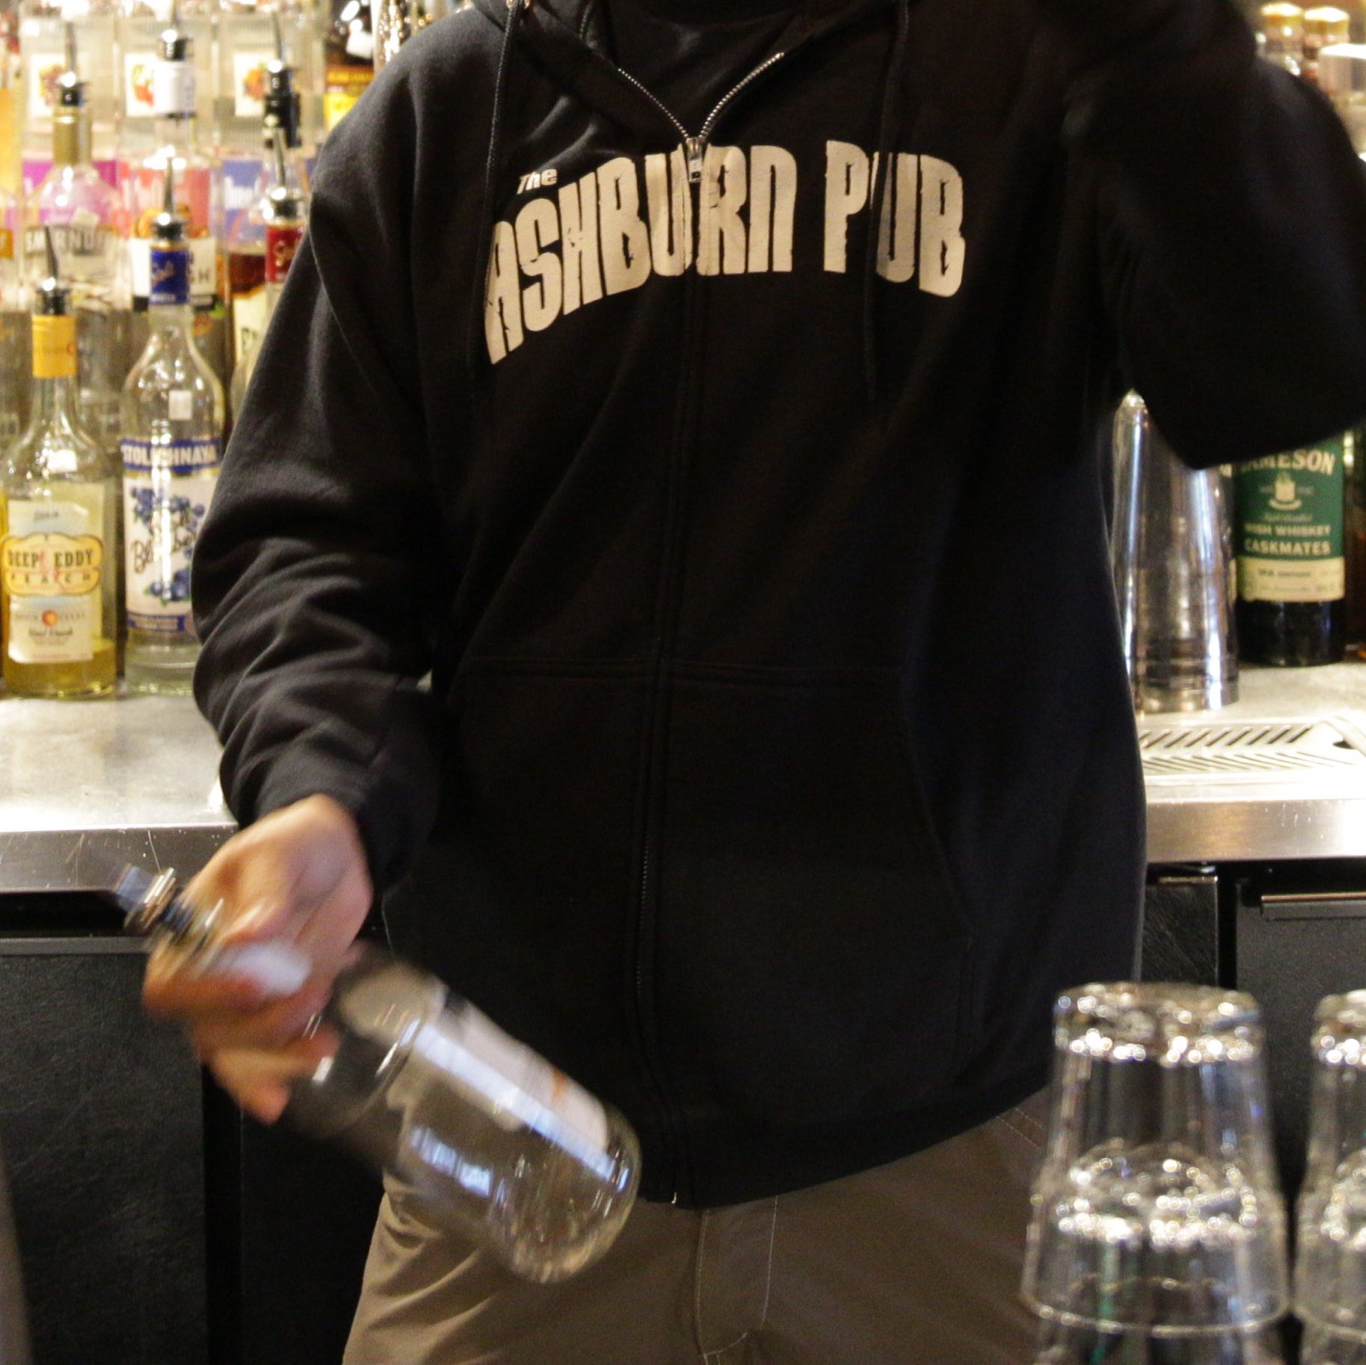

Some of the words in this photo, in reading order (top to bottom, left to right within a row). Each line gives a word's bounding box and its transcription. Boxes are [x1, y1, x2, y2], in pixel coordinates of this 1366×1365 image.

[517, 166, 558, 195] The
[25, 228, 116, 253] SMRNOFF
[483, 142, 798, 365] ASHBURN
[823, 139, 967, 298] PUB
[120, 444, 218, 466] STOLHNAYA
[1275, 524, 1332, 537] WHISKEY
[7, 550, 41, 568] DEEP
[54, 548, 94, 568] EDDY
[1244, 539, 1332, 555] CASKMATES
